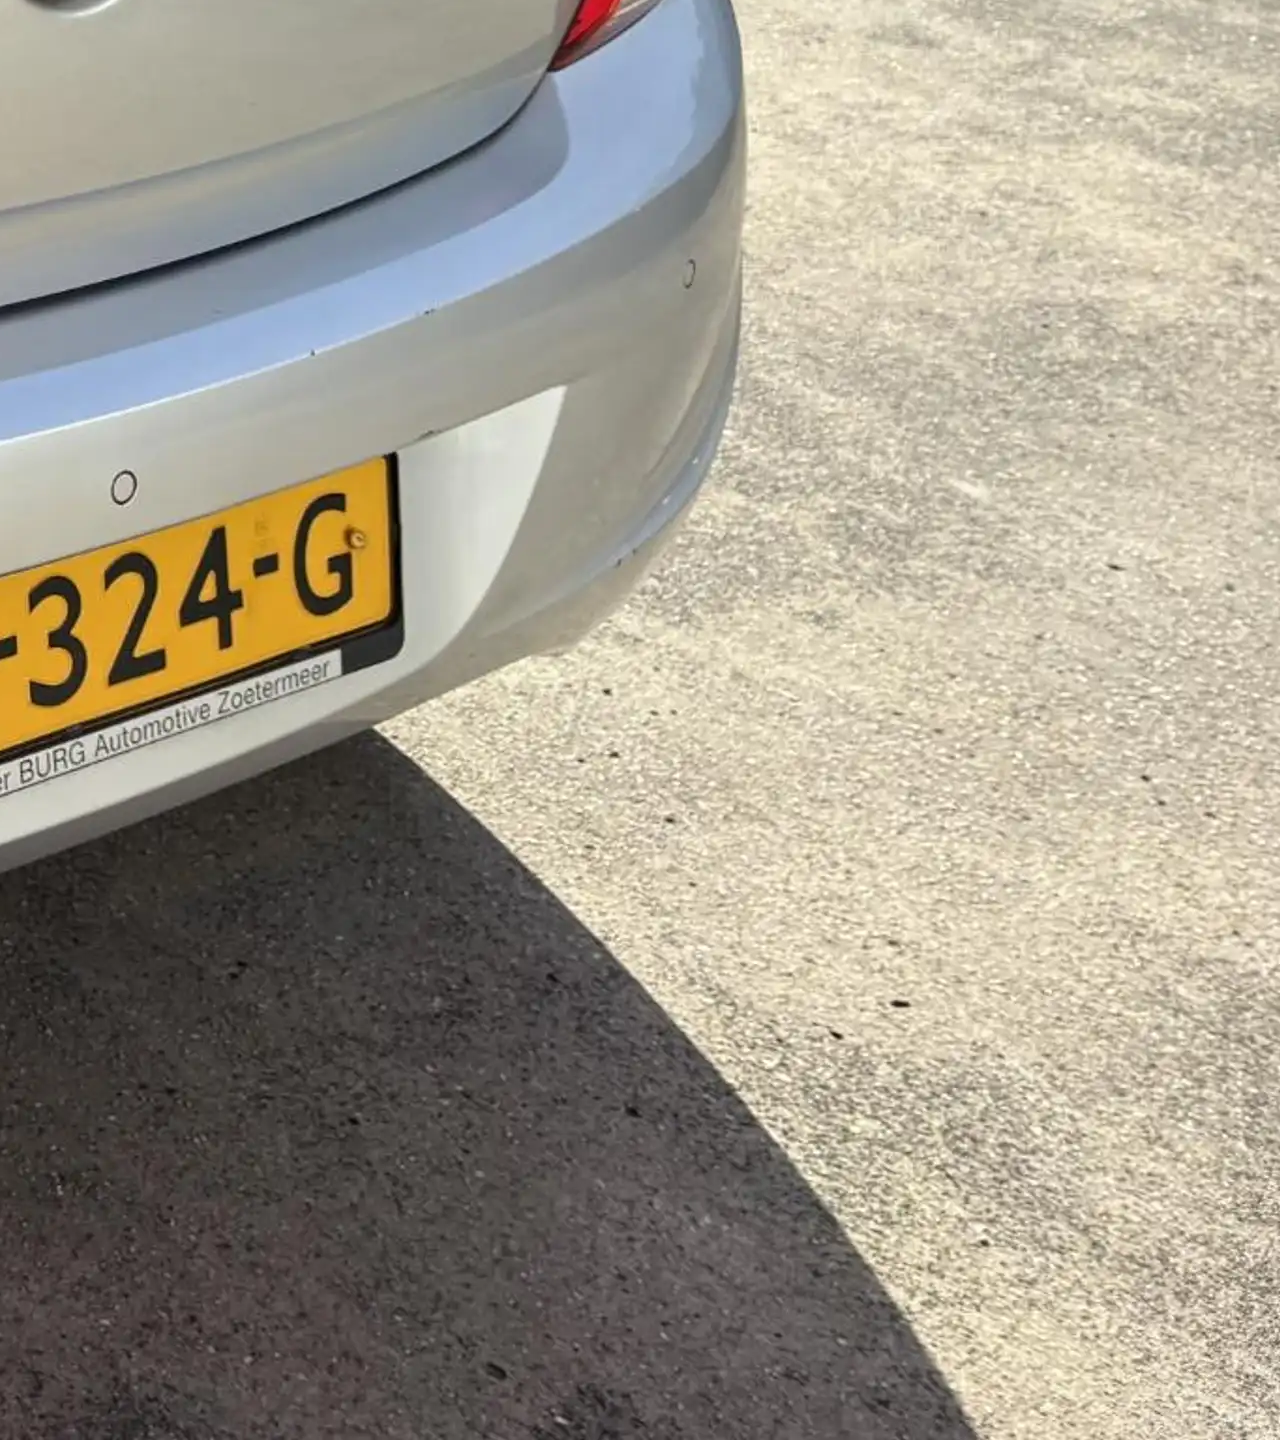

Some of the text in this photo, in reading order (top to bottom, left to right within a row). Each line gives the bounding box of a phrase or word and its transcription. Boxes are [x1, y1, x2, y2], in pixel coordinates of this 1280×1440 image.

[19, 741, 86, 784] BURG
[95, 702, 211, 758] Automotive
[218, 658, 331, 713] Zoetermeer
